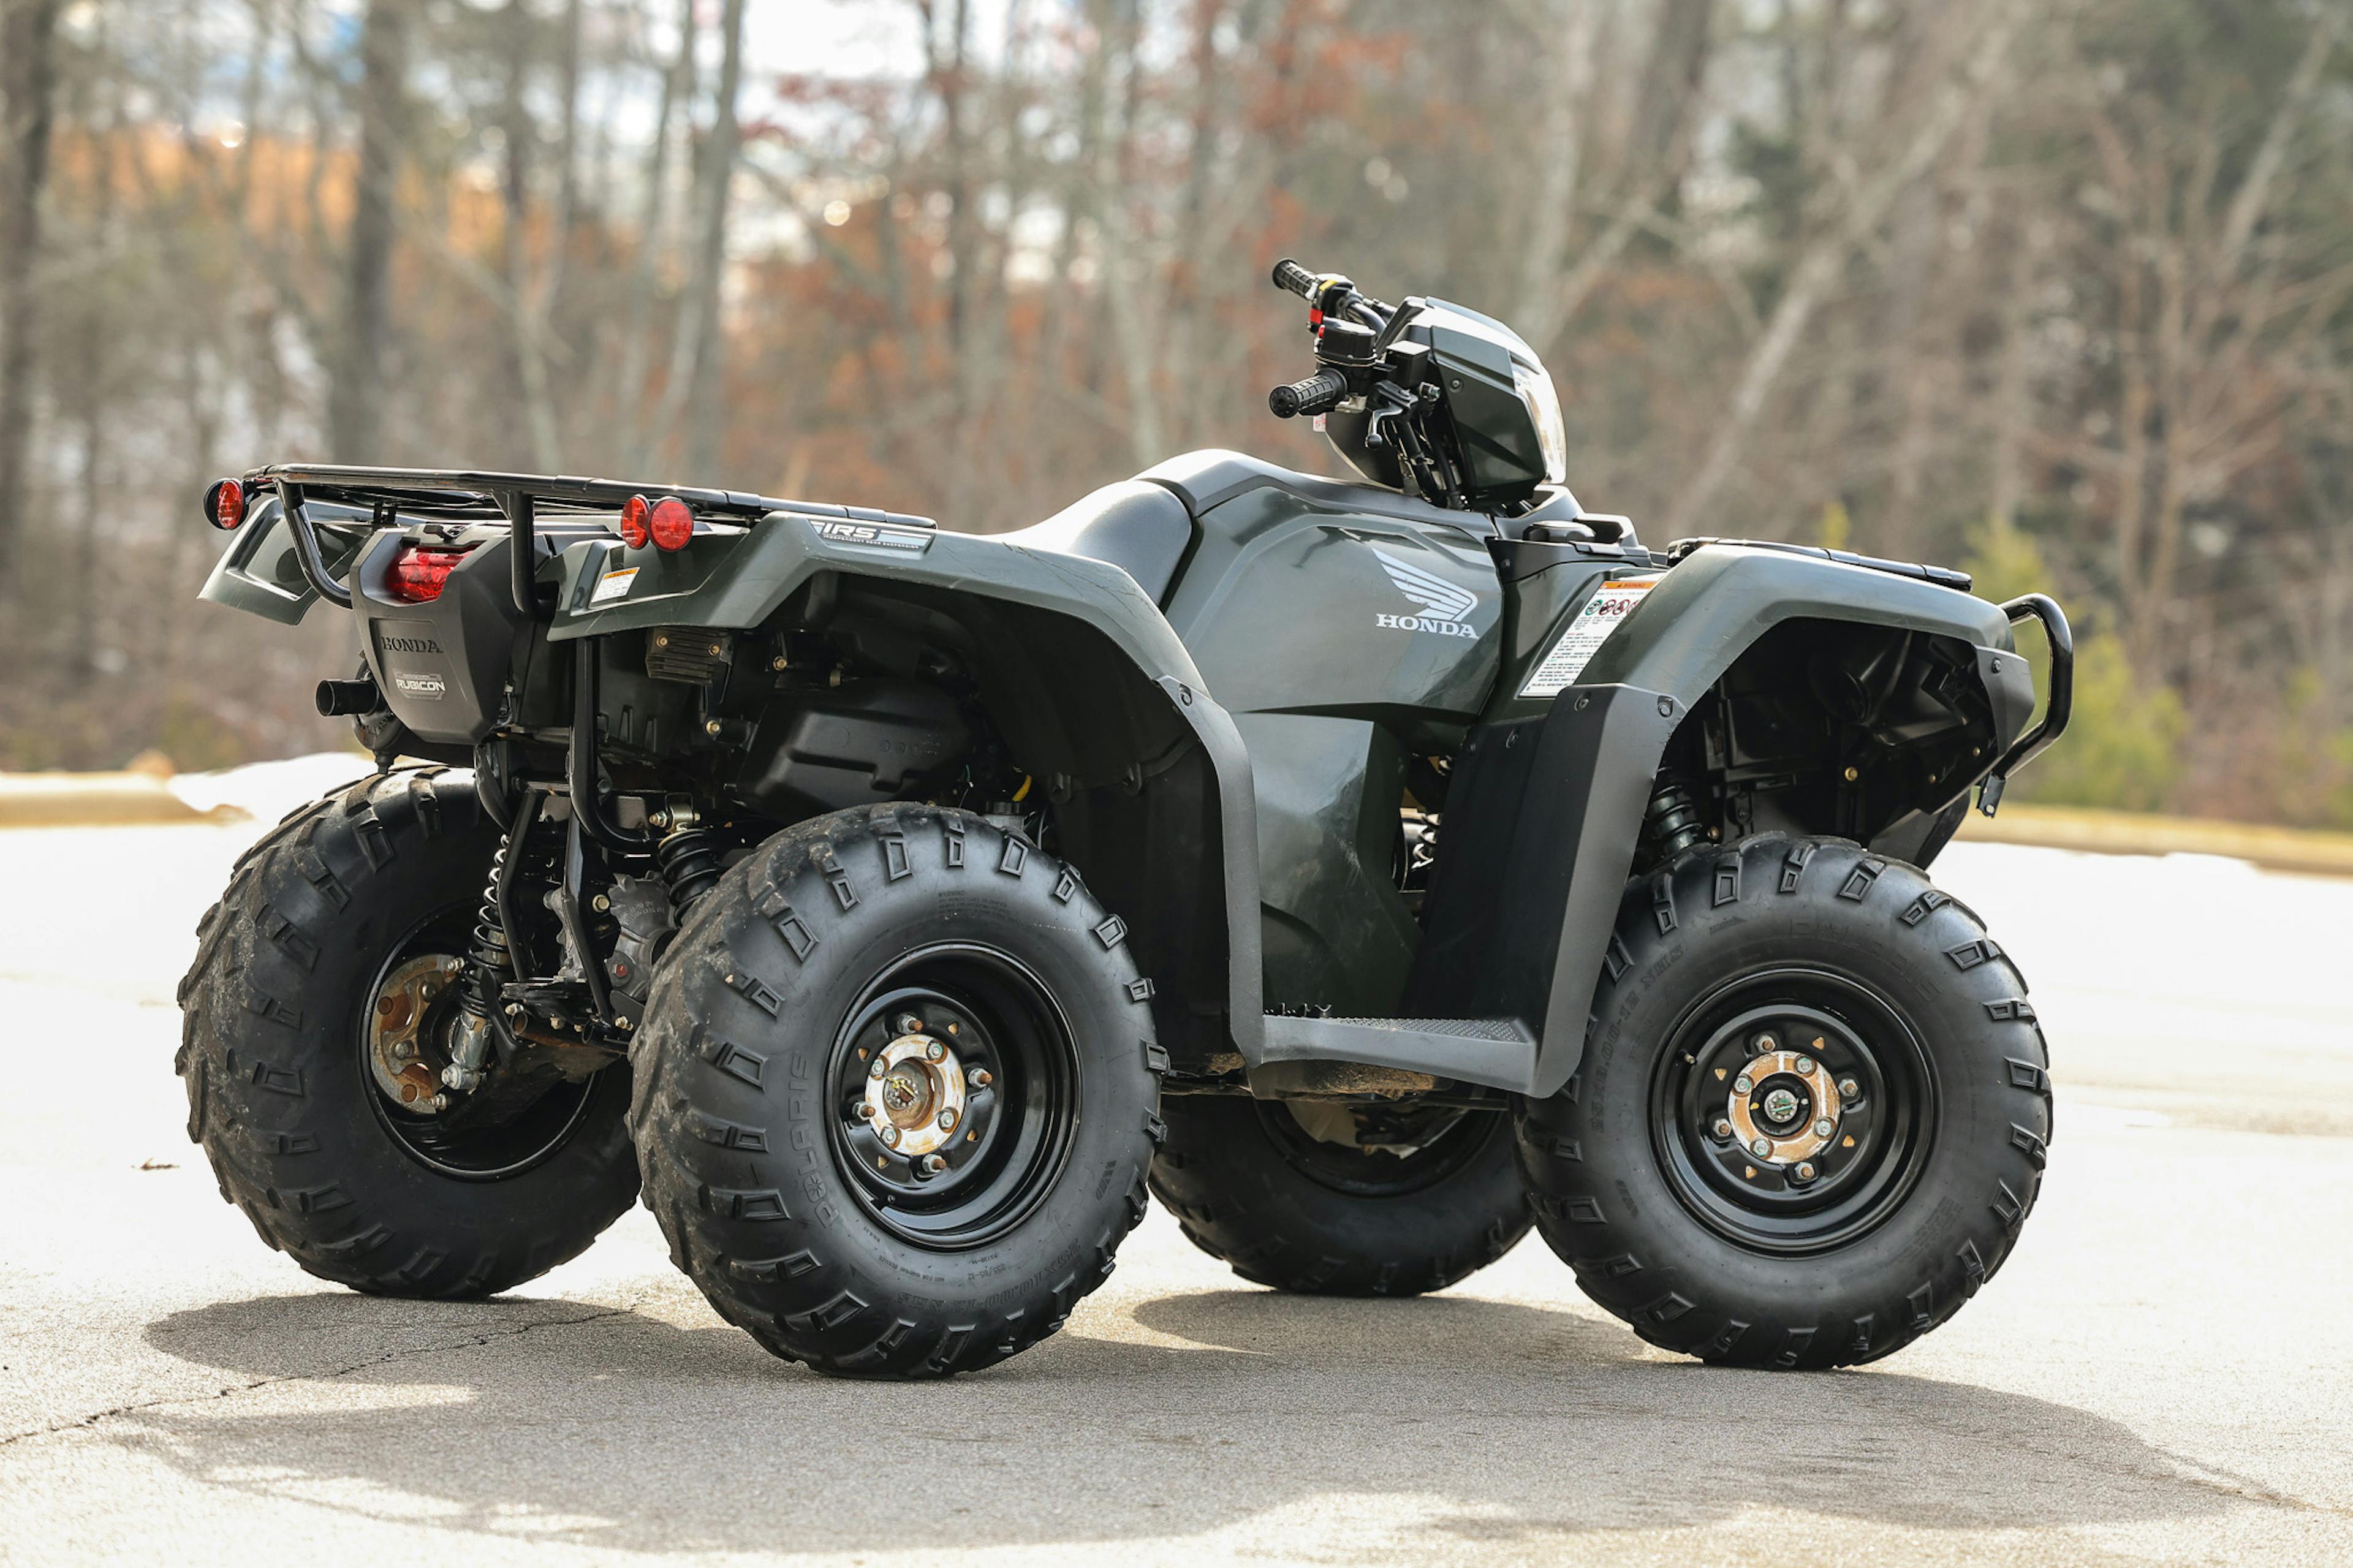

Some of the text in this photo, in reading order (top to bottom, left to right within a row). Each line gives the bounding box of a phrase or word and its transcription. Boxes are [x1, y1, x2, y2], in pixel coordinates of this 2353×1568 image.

[823, 523, 877, 539] IRS
[1376, 613, 1479, 639] HONDA
[381, 637, 444, 653] HONDA
[396, 679, 445, 691] RUBICON
[789, 1050, 841, 1228] POLARIS
